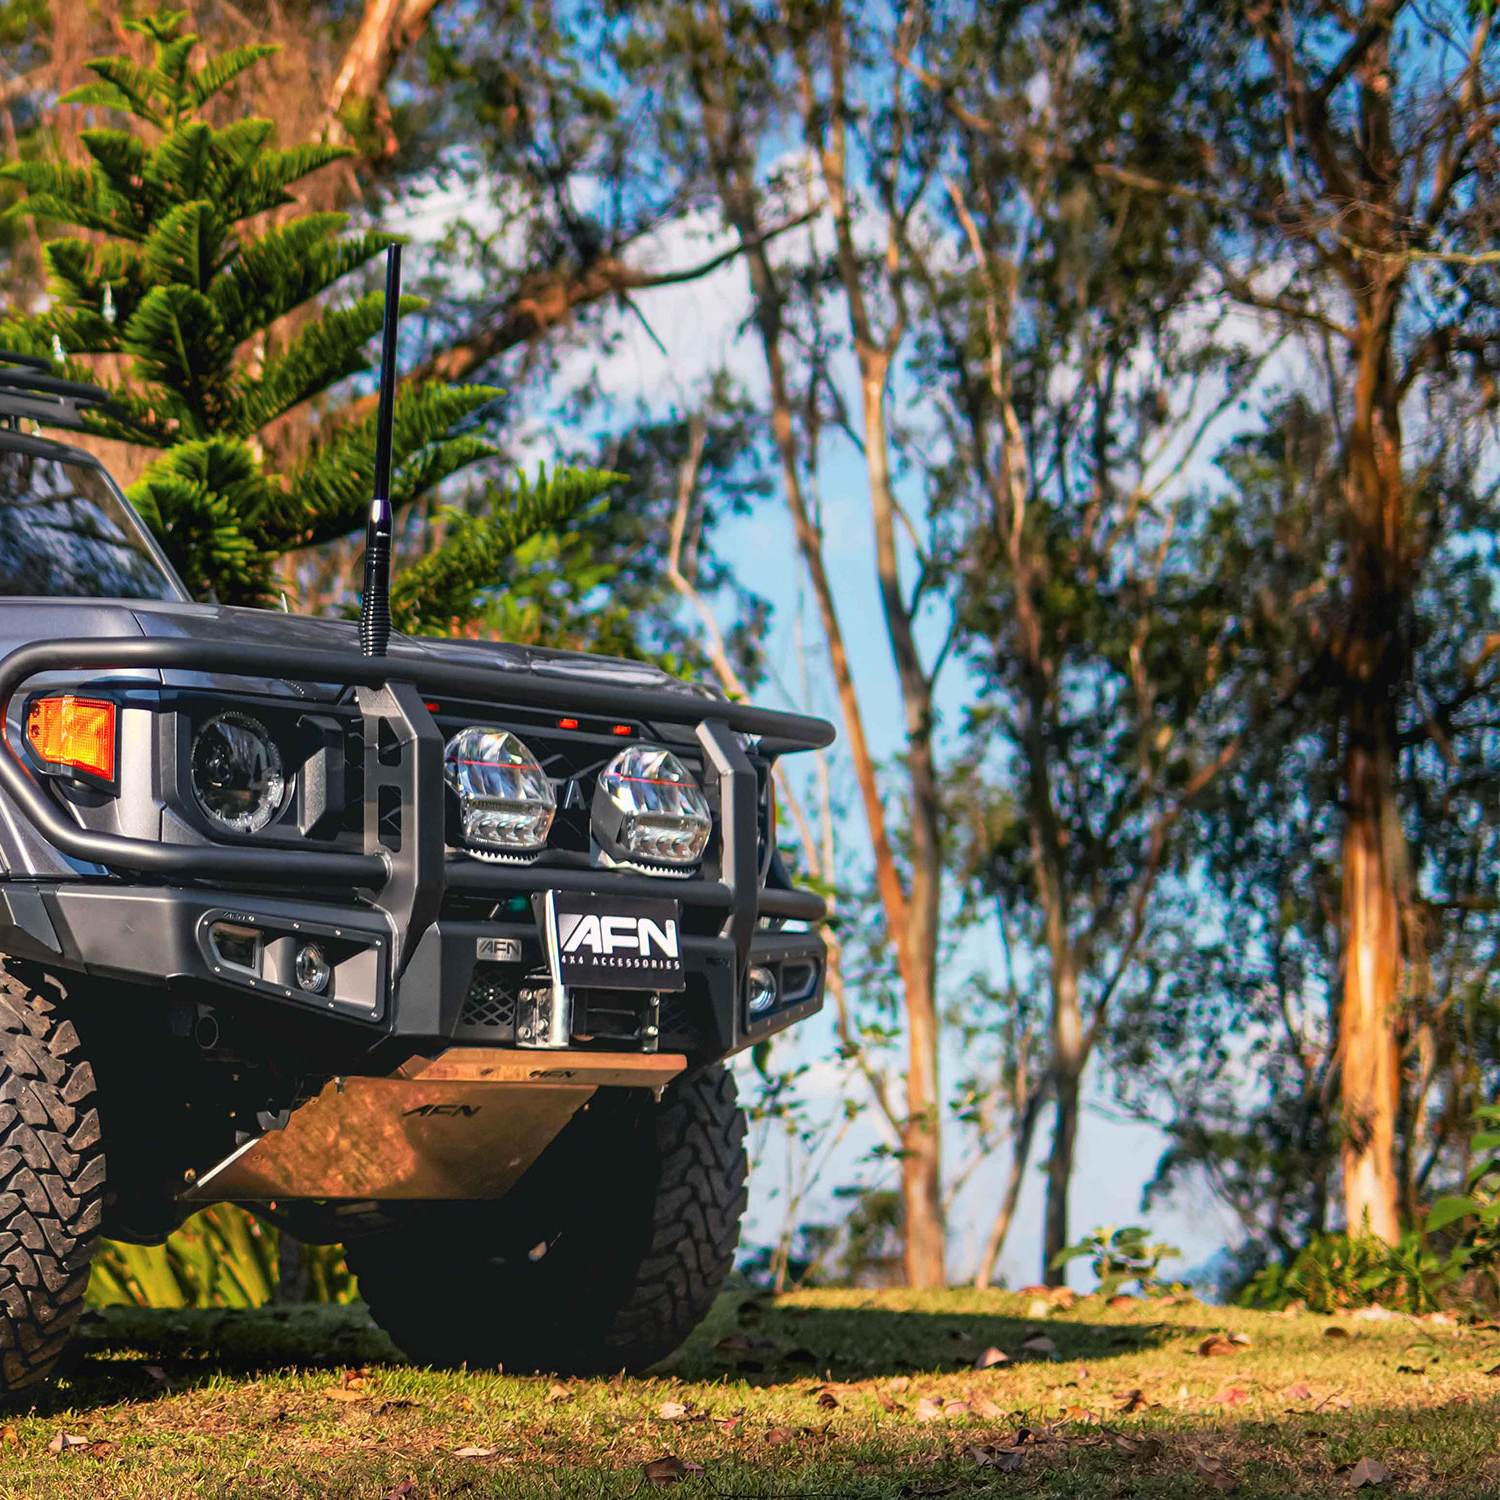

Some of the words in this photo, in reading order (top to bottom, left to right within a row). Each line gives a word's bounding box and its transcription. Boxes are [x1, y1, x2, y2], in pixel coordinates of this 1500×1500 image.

[558, 913, 679, 957] AFN
[479, 940, 520, 954] AFN
[592, 956, 680, 970] ACCESSORIES
[402, 1104, 483, 1117] AFN
